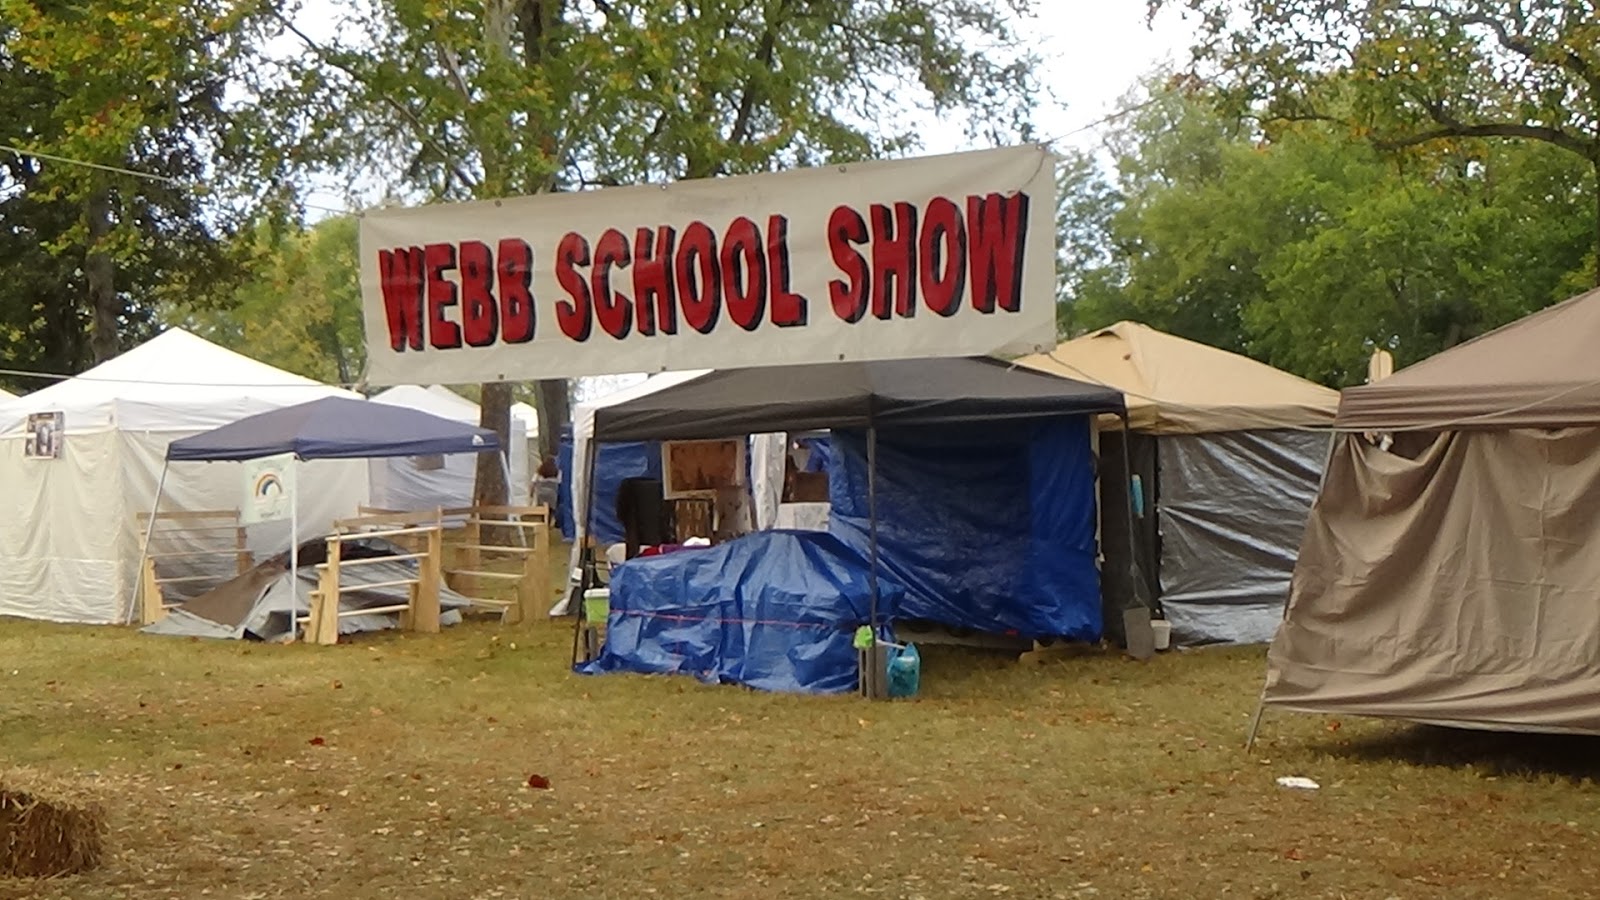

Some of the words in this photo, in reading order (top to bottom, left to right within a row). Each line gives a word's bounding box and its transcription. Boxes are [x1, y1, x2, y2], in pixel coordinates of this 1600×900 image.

[378, 238, 535, 352] WEBB
[555, 214, 807, 342] SCHOOL
[827, 191, 1029, 324] SHOW
